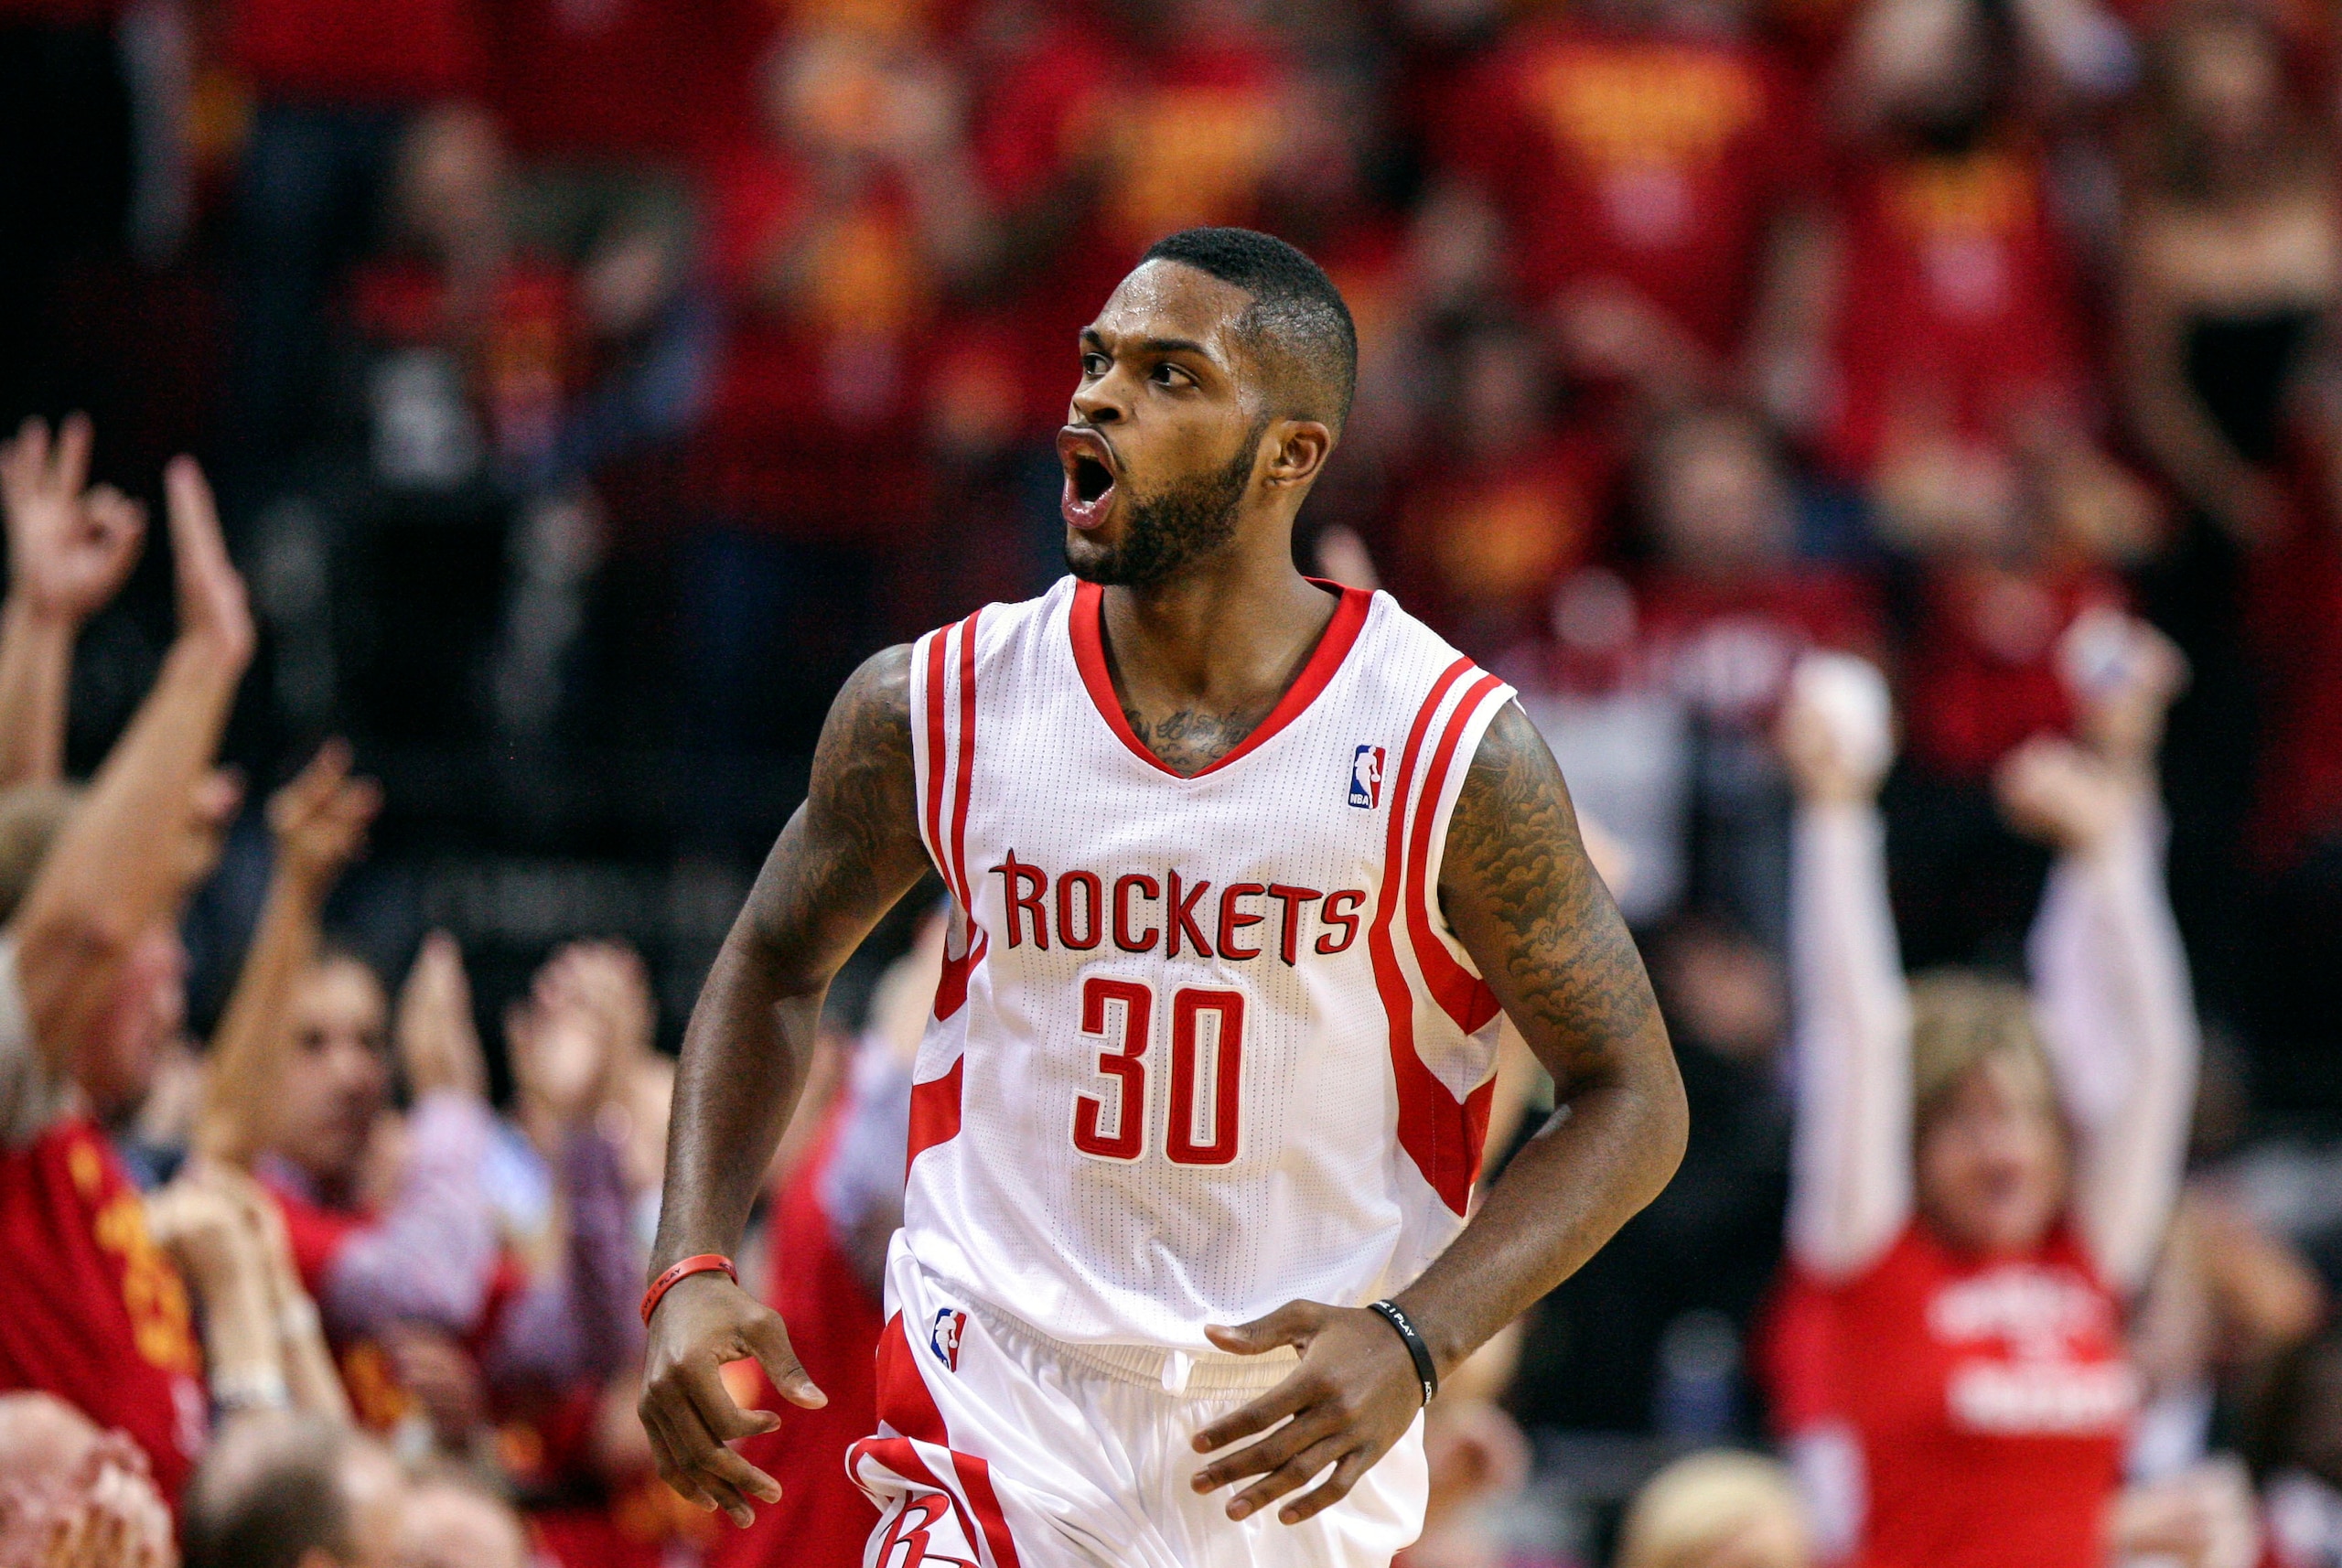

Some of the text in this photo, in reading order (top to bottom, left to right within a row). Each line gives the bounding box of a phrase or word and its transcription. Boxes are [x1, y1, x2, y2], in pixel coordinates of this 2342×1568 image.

[1349, 793, 1370, 805] NBA
[988, 847, 1367, 967] ROCKETS
[1070, 973, 1249, 1168] 30
[659, 1268, 681, 1287] PLAY
[1394, 1314, 1414, 1336] PLAY
